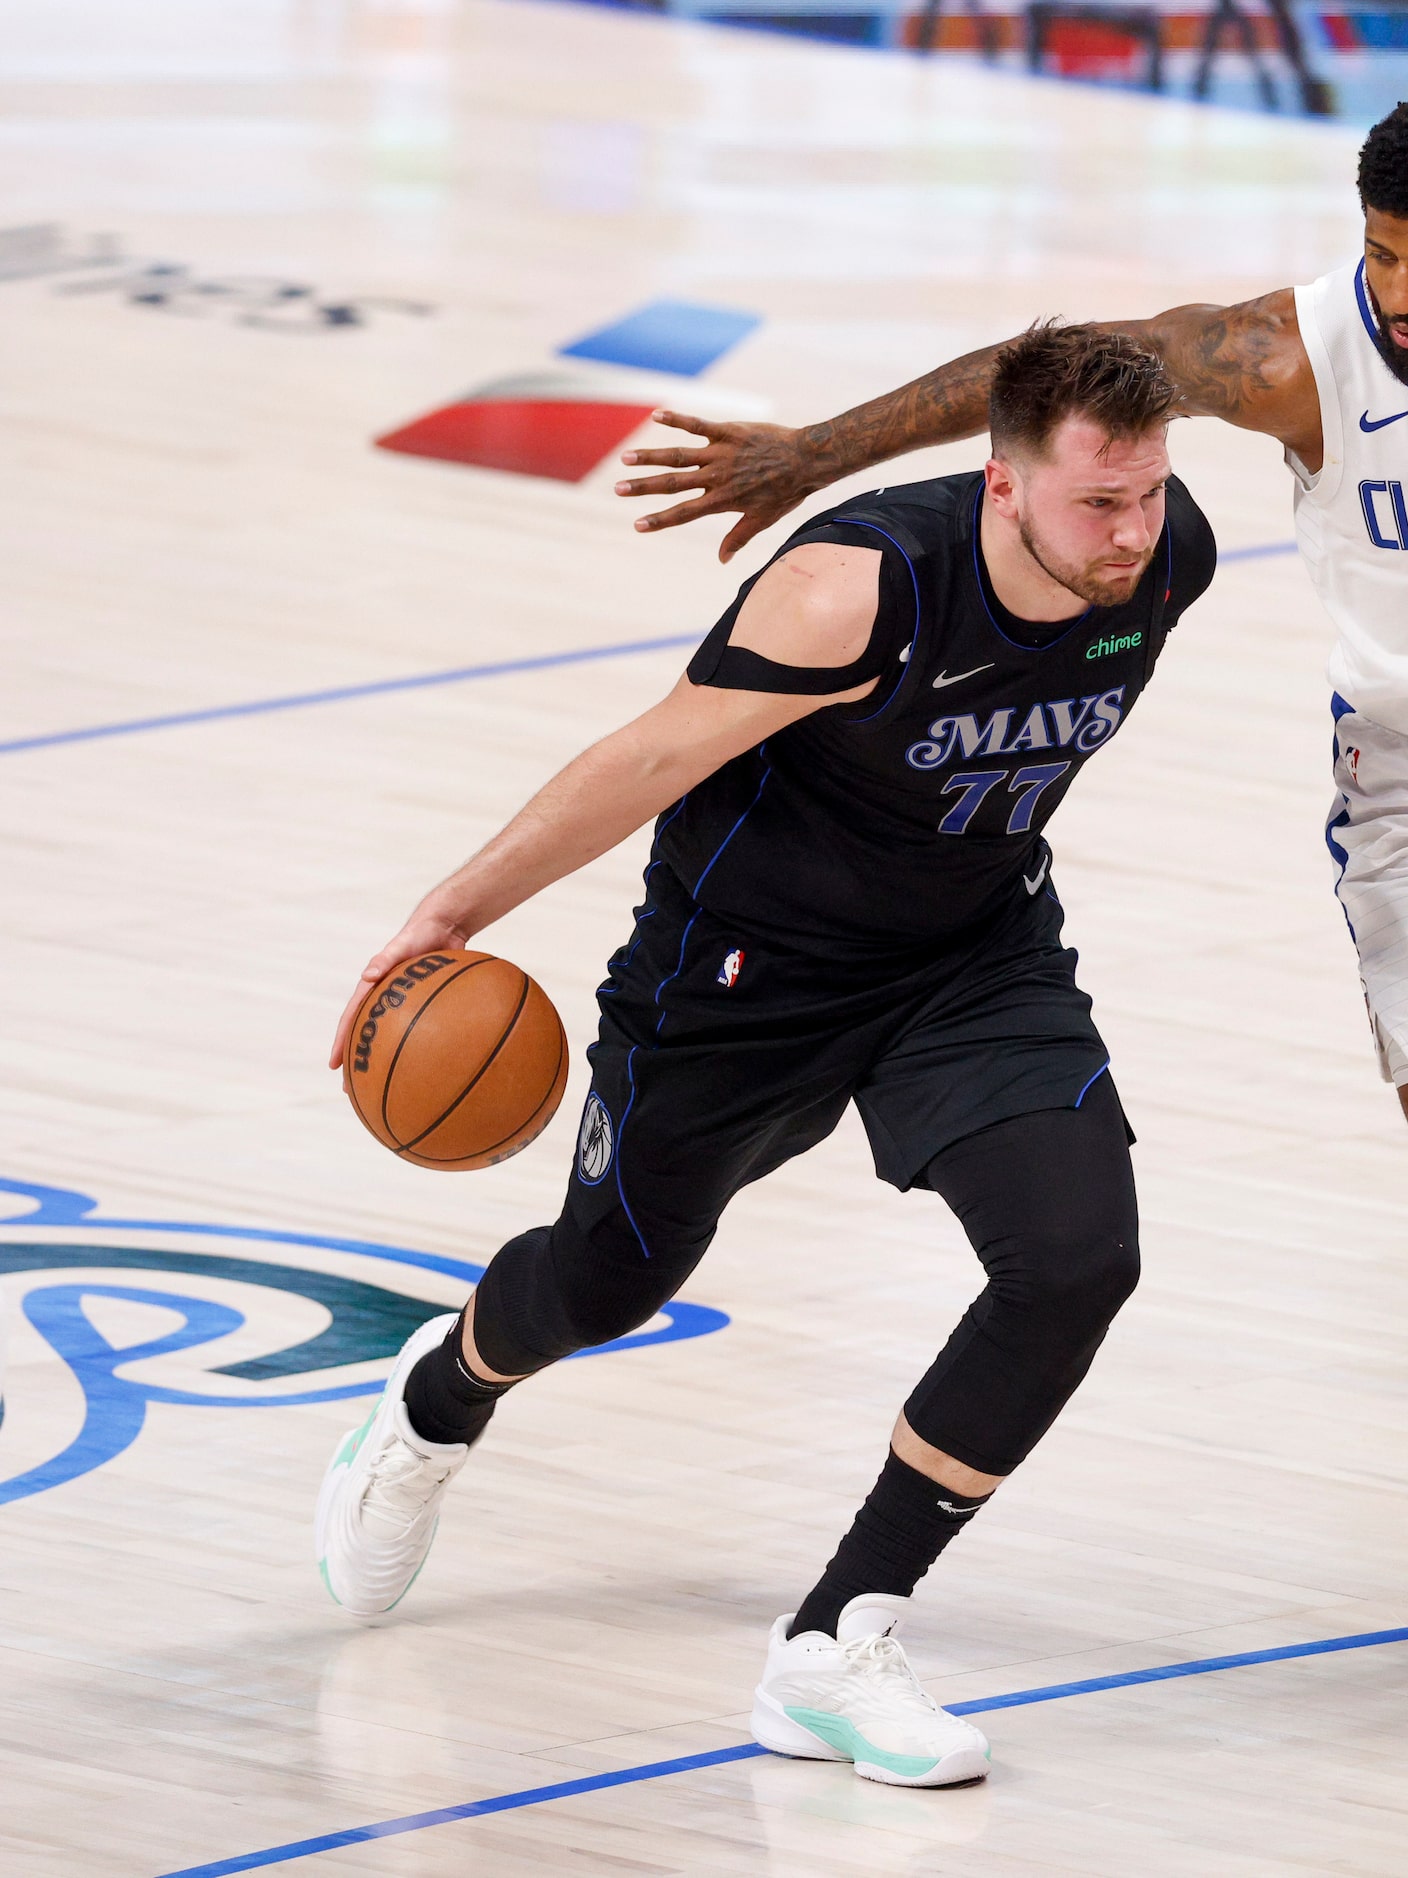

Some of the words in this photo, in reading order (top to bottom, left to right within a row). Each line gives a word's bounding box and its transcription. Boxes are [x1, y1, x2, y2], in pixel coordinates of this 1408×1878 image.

[1085, 630, 1143, 660] chime
[905, 684, 1126, 770] MAVS
[937, 760, 1071, 834] 77
[354, 954, 458, 1073] Wilson
